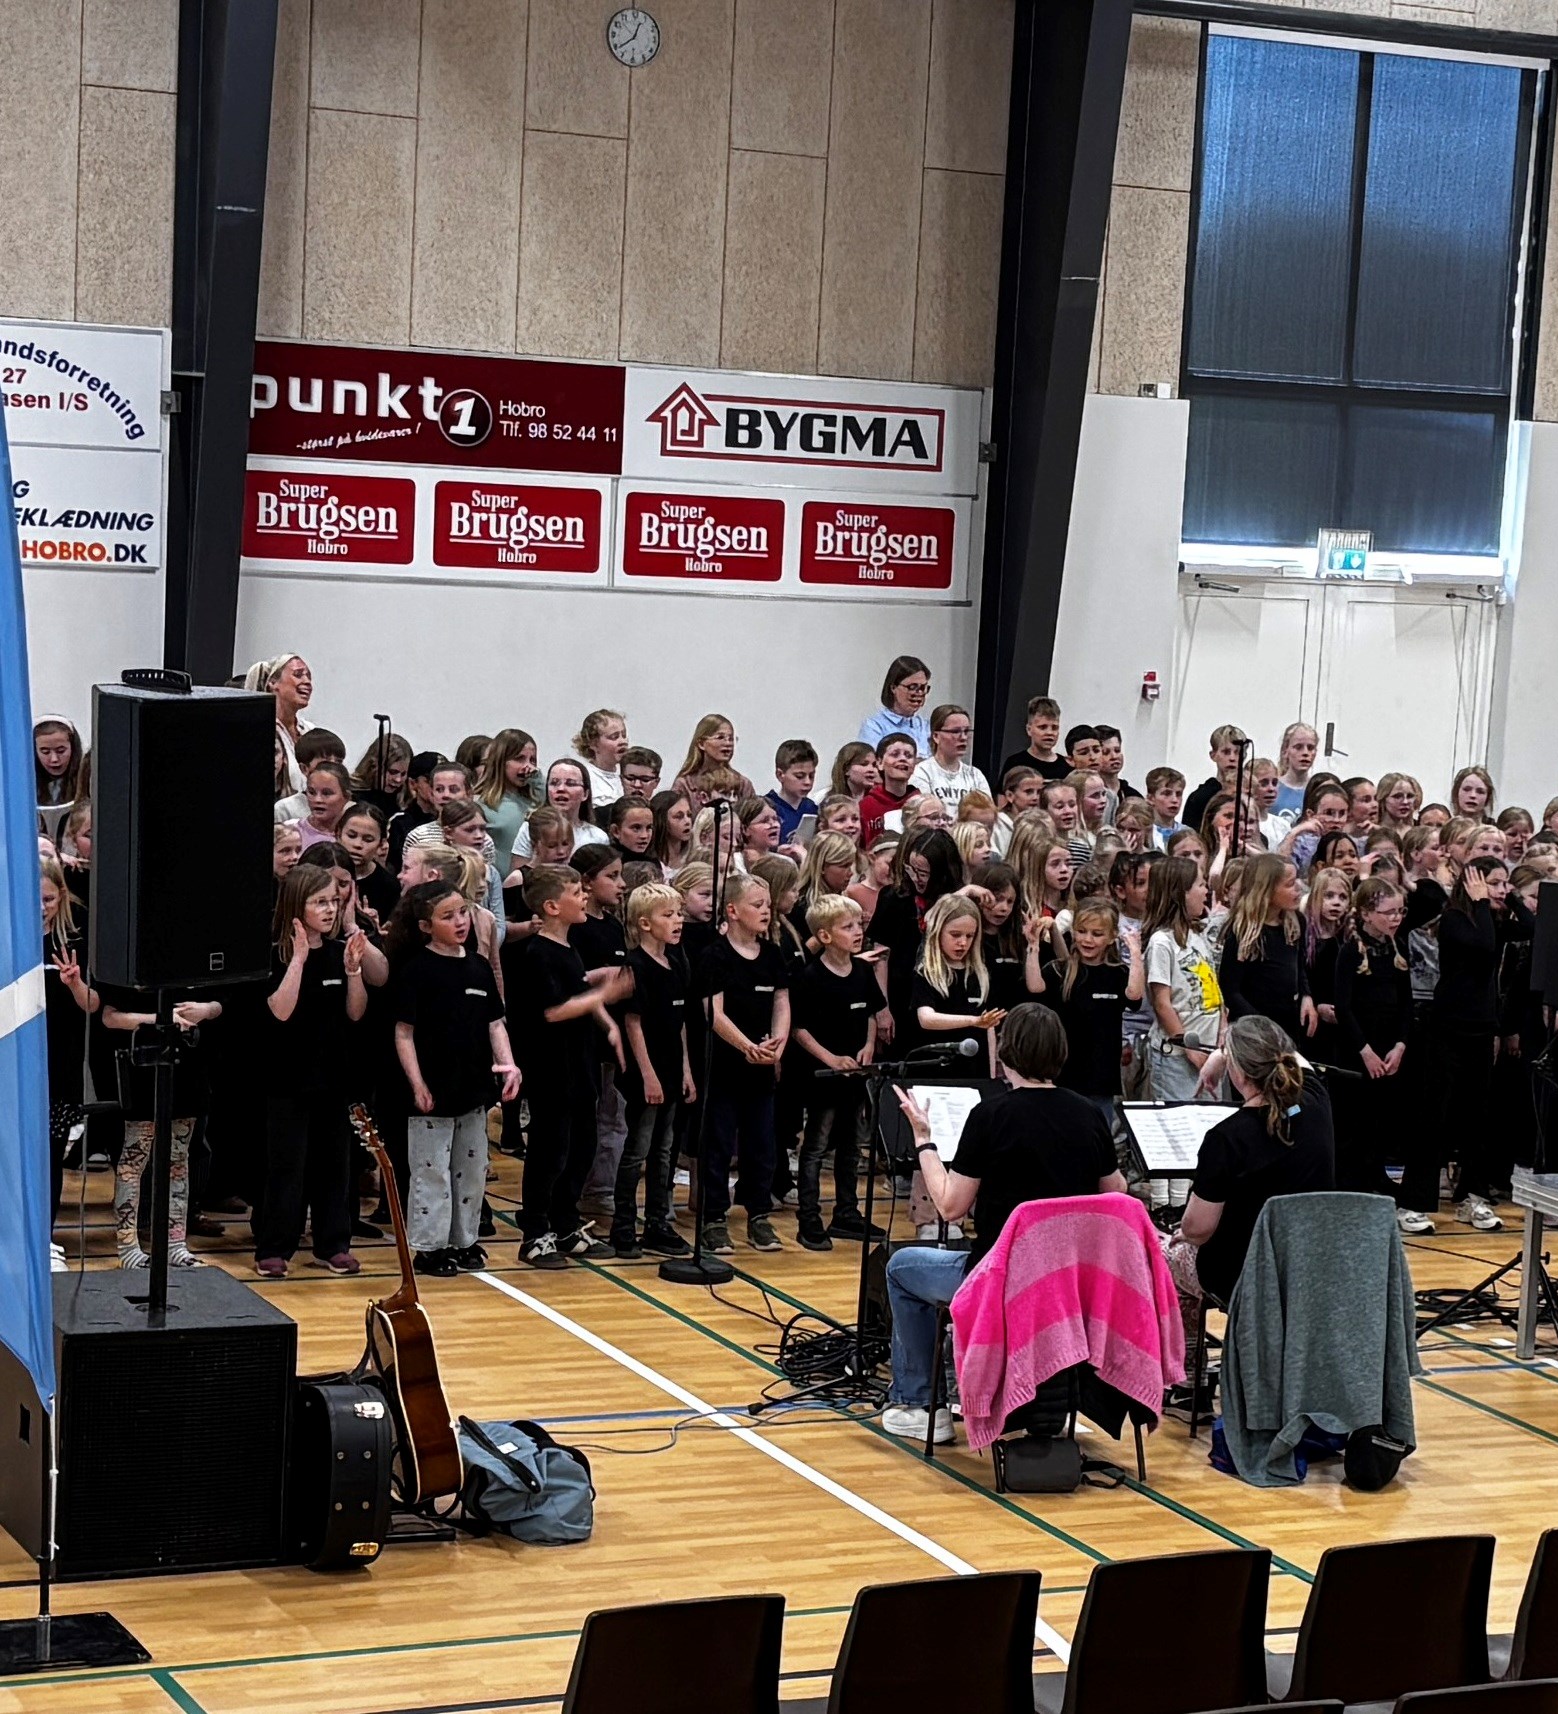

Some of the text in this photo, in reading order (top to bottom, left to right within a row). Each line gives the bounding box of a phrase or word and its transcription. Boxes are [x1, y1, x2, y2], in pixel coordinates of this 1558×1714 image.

[3, 368, 27, 384] 27
[0, 340, 145, 440] ndsforretning
[250, 372, 443, 421] punkt
[59, 392, 89, 411] I/S
[500, 400, 546, 418] Hobro
[528, 423, 548, 439] 98
[553, 424, 572, 440] 52
[576, 426, 597, 441] 44
[603, 428, 618, 442] 11
[724, 407, 929, 459] BYGMA
[279, 479, 329, 501] Super
[472, 489, 519, 511] Super
[256, 492, 398, 540] Brugsen
[661, 500, 706, 522] Super
[836, 509, 879, 530] Super
[450, 502, 585, 549] Brugsen
[639, 512, 769, 558] Brugsen
[307, 538, 348, 555] Hobro
[815, 521, 938, 566] Brugsen
[498, 548, 537, 564] Hobro
[685, 557, 722, 573] Hobro
[858, 565, 894, 580] Hobro
